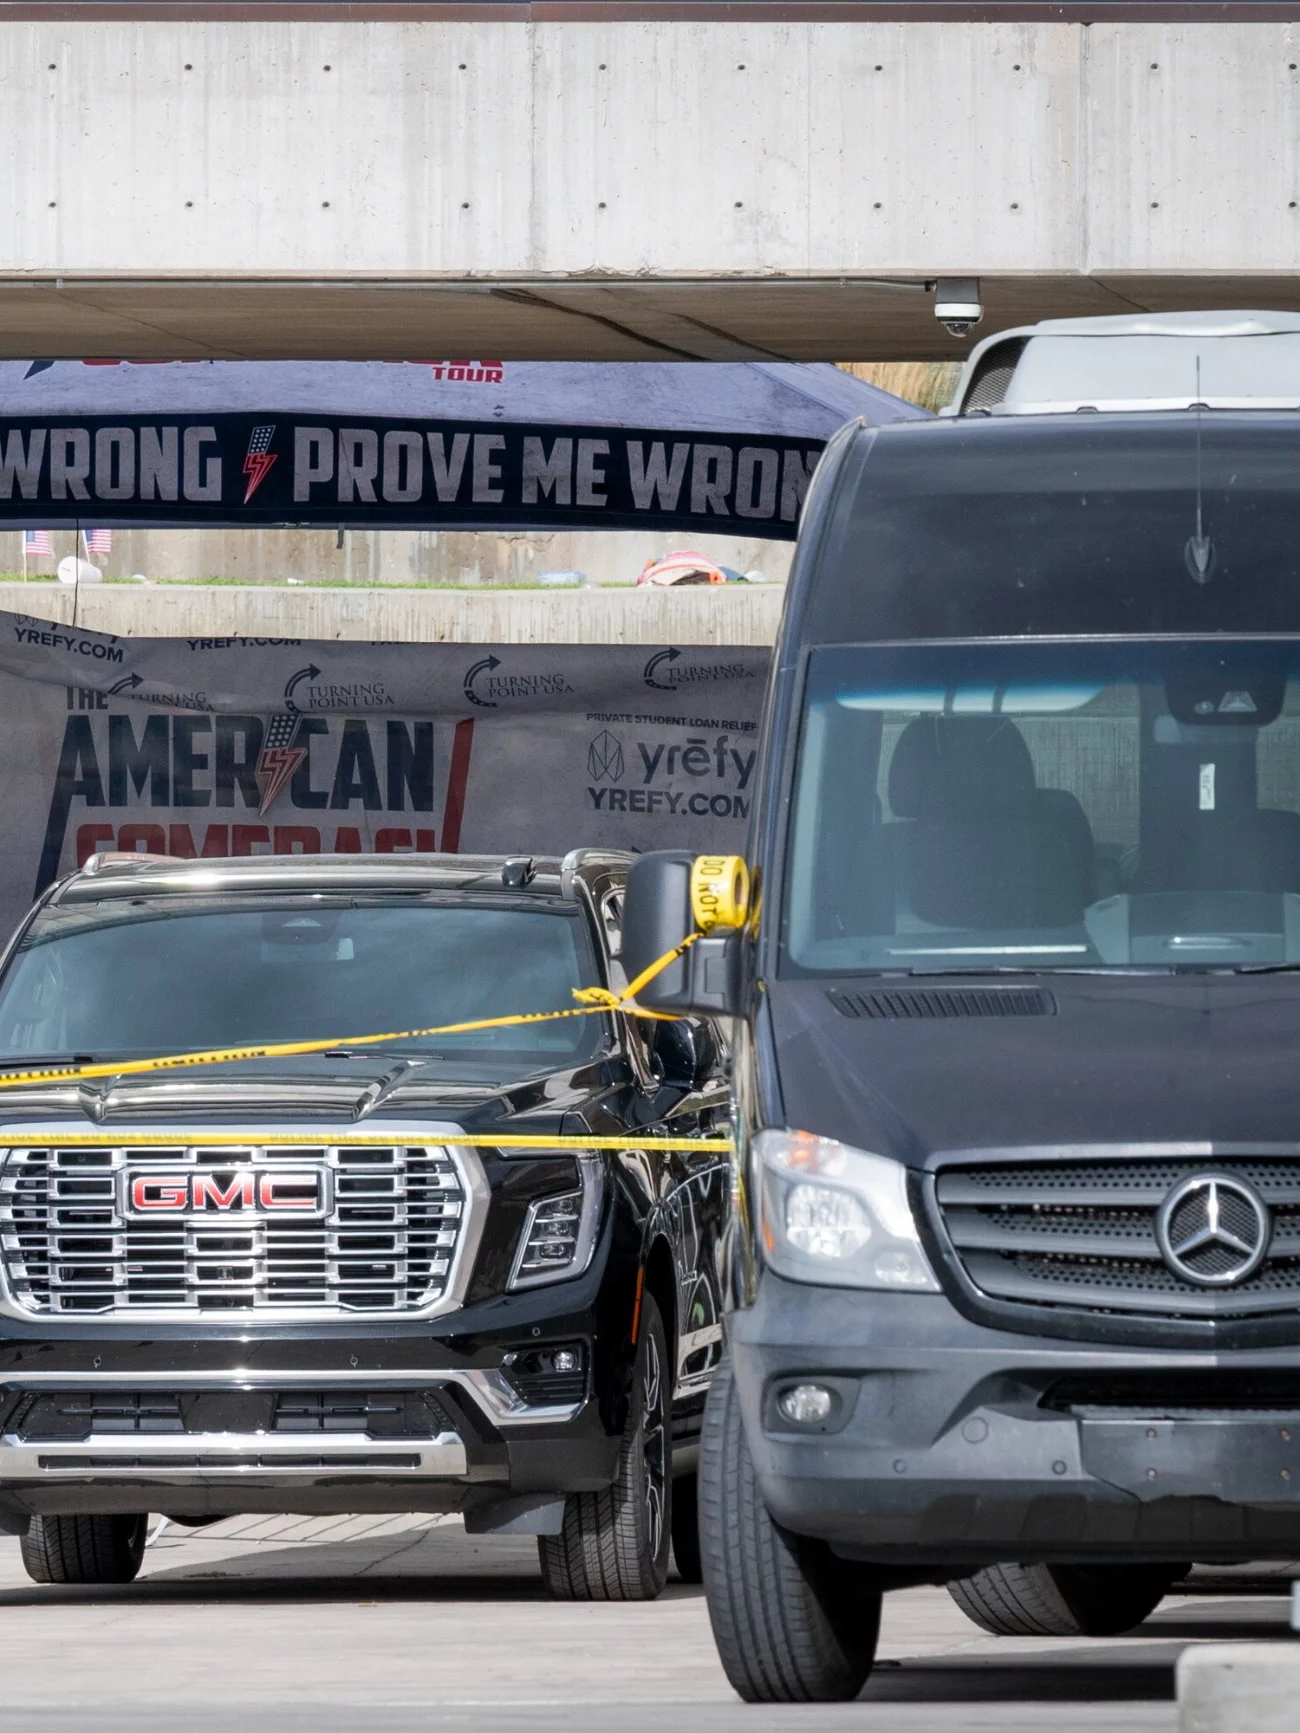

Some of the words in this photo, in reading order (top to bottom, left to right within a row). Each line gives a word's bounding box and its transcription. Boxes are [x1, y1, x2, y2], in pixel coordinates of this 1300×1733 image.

[432, 366, 503, 384] TOUR
[293, 426, 504, 505] PROVE
[521, 436, 611, 507] ME
[14, 627, 124, 662] YREFY.COM
[668, 663, 746, 677] TURNING
[486, 673, 565, 689] TURNING
[488, 685, 541, 698] POINT
[544, 682, 575, 695] USA
[307, 682, 386, 699] TURNING
[308, 695, 360, 709] POINT
[363, 694, 396, 706] USA
[586, 712, 632, 724] PRIVATE
[635, 715, 687, 727] STUDENT
[689, 717, 719, 730] LOAN
[721, 719, 758, 732] RELIEF
[587, 786, 750, 819] YREFY.COM
[132, 1173, 318, 1211] GMC
